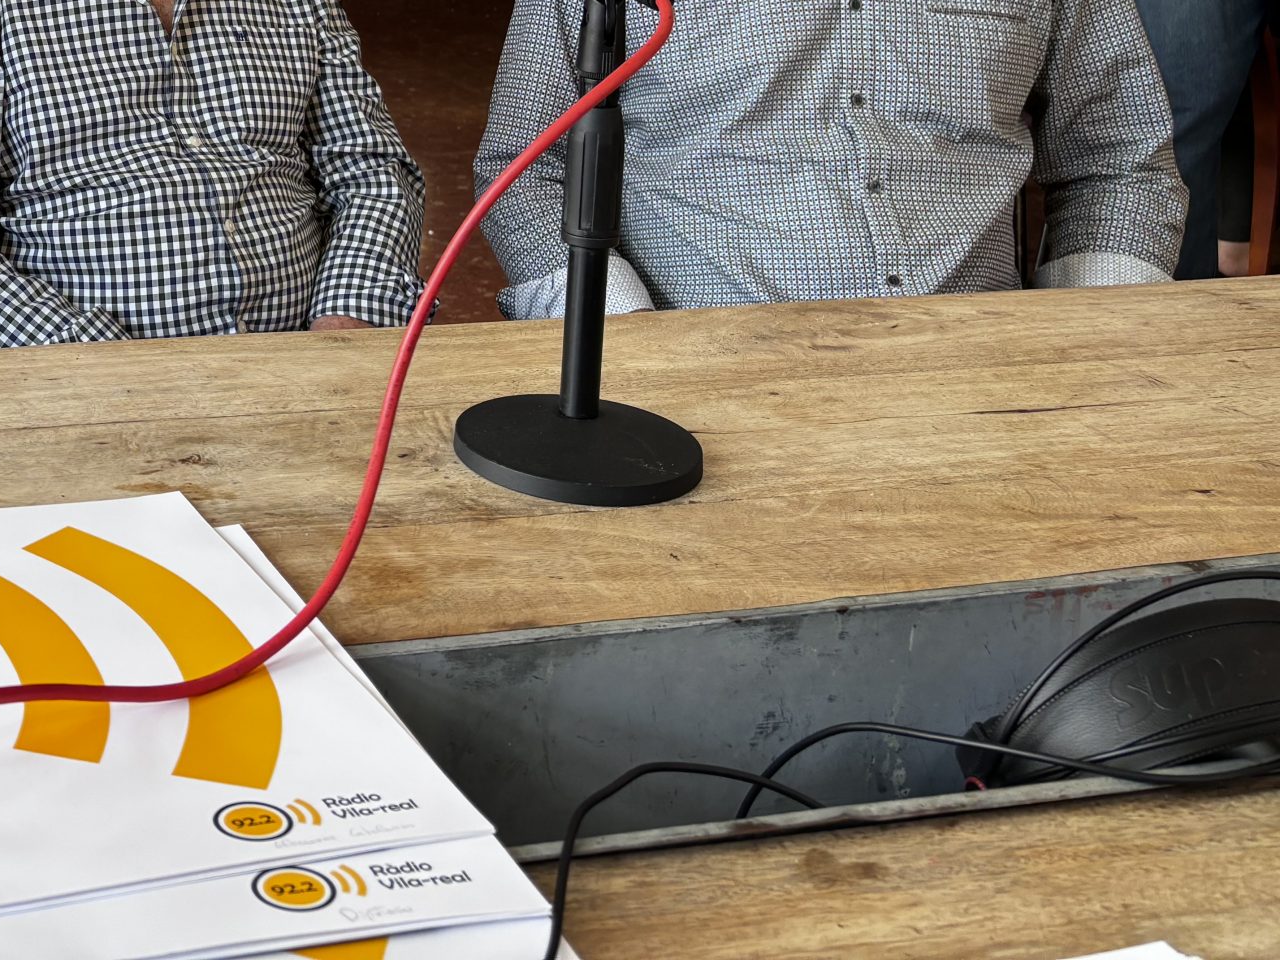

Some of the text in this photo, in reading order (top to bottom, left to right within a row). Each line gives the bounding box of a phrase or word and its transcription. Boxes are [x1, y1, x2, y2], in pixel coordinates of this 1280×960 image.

[321, 792, 382, 809] Ràdio
[231, 799, 419, 830] 92.2 Vila-real
[369, 861, 433, 877] Ràdio
[270, 871, 473, 897] 92.2 Vila-real
